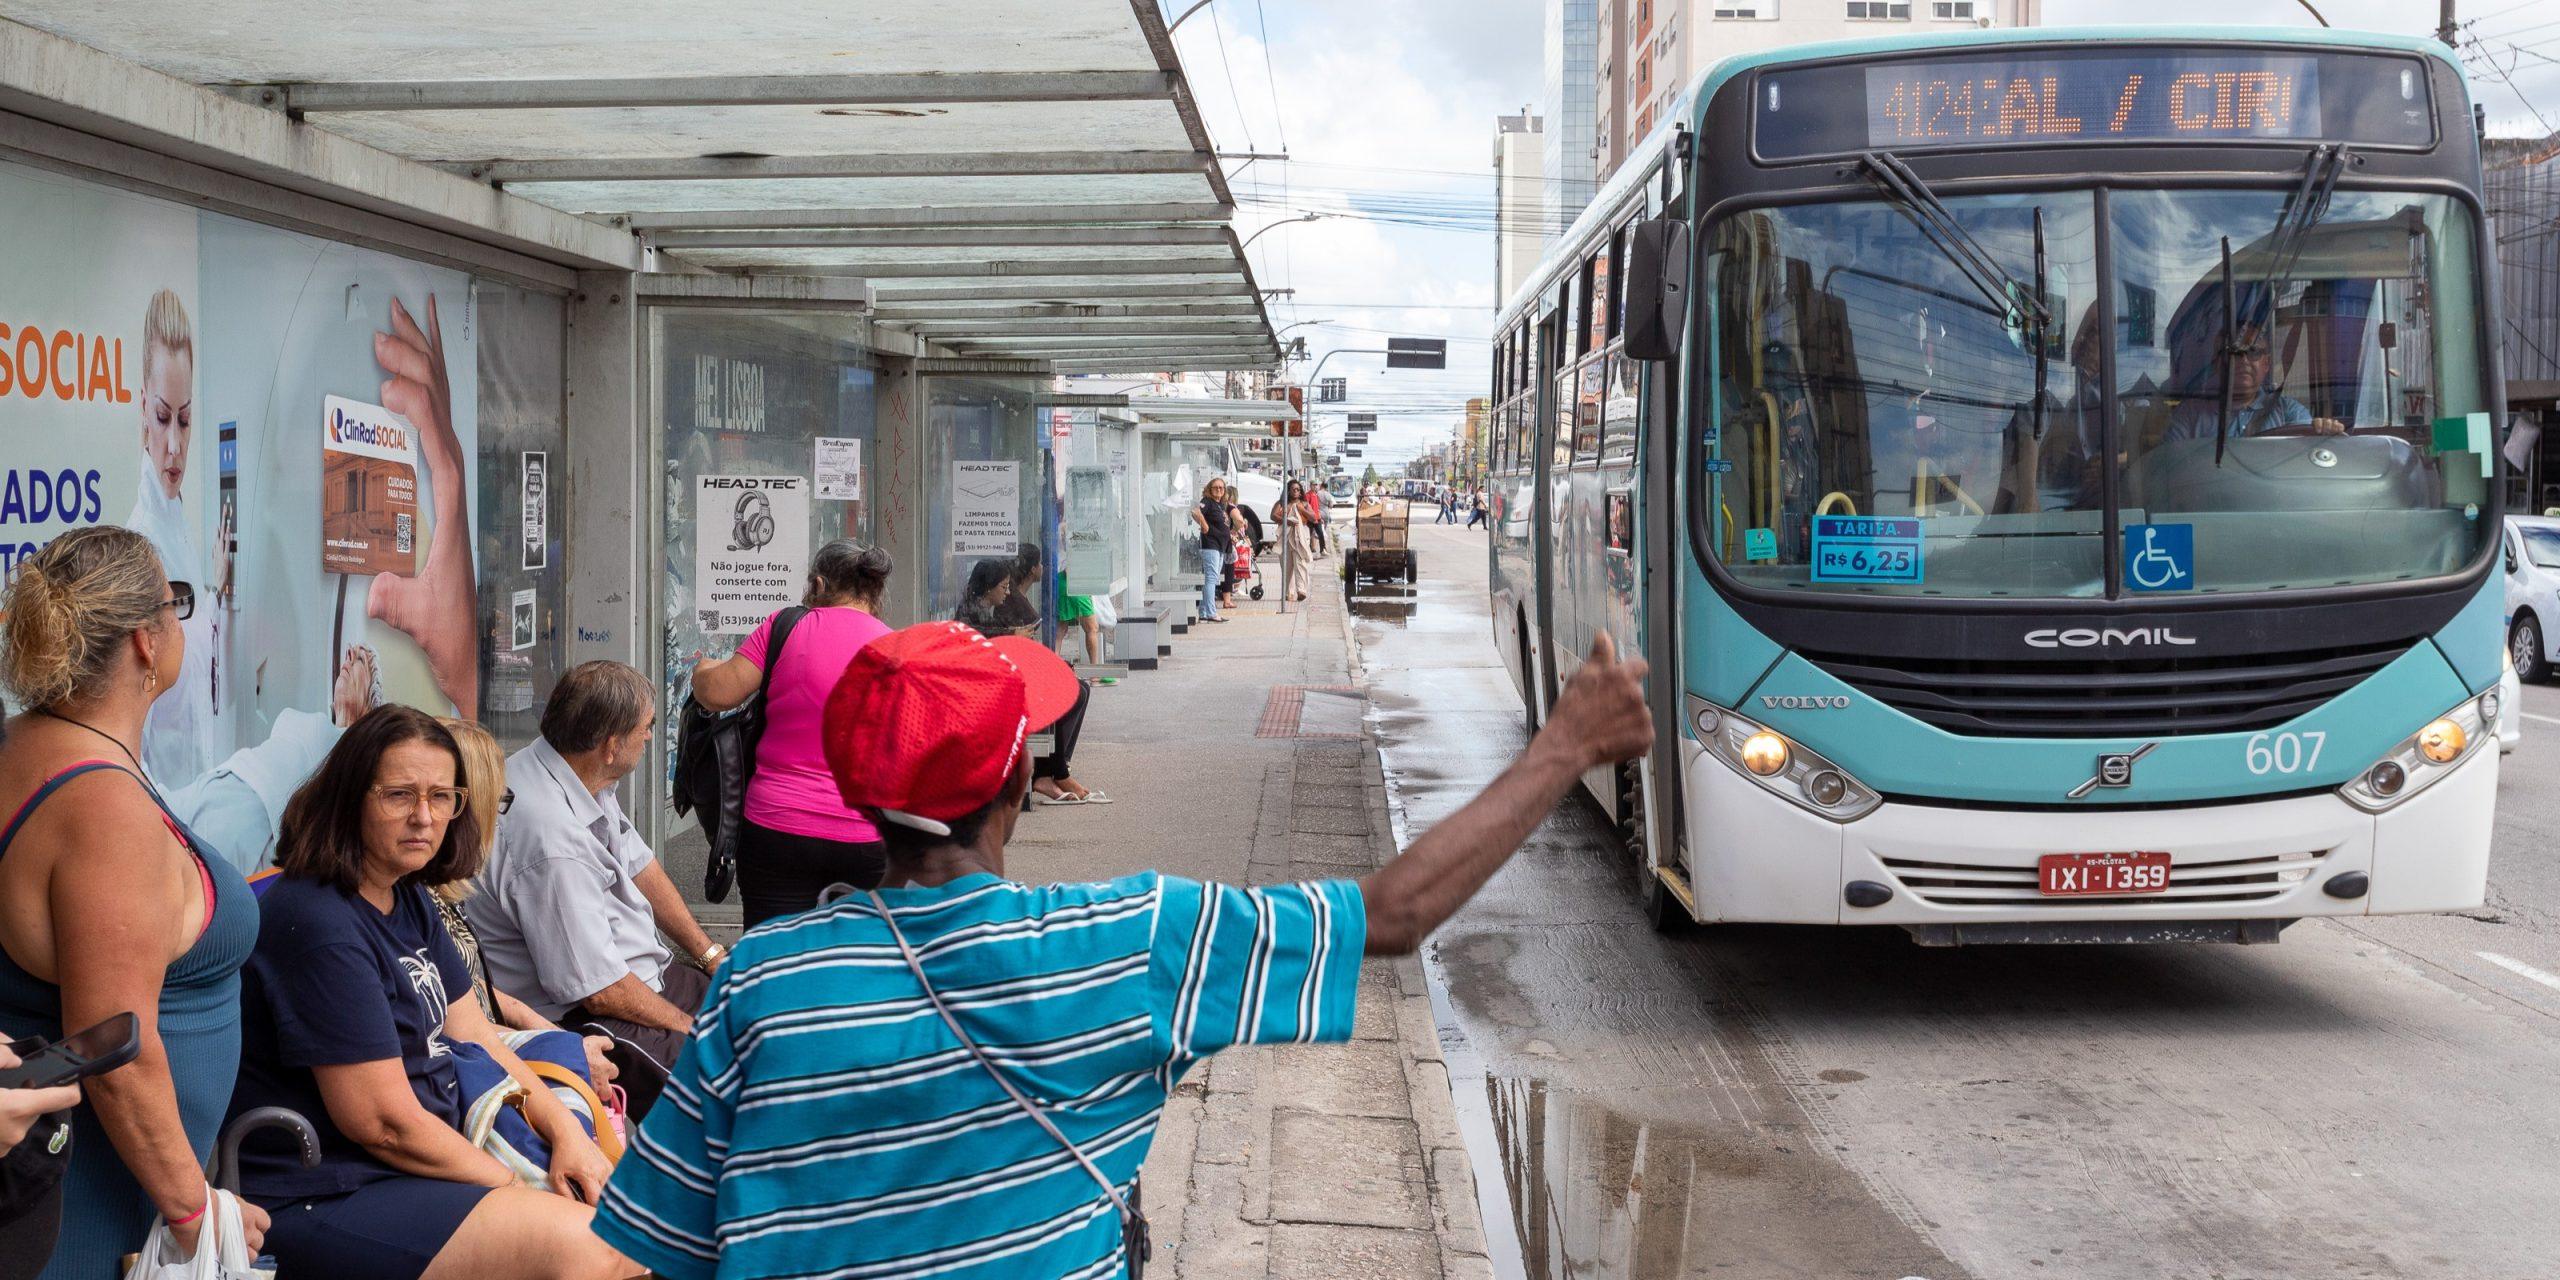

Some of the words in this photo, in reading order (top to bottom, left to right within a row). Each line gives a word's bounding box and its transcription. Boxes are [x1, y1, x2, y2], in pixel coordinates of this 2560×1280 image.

[0, 322, 132, 403] SOCIAL
[695, 353, 722, 428] MEL
[725, 358, 766, 433] LISBOA
[703, 478, 759, 489] HEAD
[711, 562, 732, 571] Não
[734, 562, 764, 573] jogue
[767, 562, 792, 573] fora,
[1824, 552, 1848, 567] R$
[1851, 550, 1910, 574] 6,25
[715, 578, 762, 587] conserte
[710, 593, 741, 602] quem
[744, 592, 791, 602] entende.
[2023, 627, 2196, 648] COMIL
[1760, 695, 1850, 709] VOLVO
[2246, 731, 2327, 775] 607
